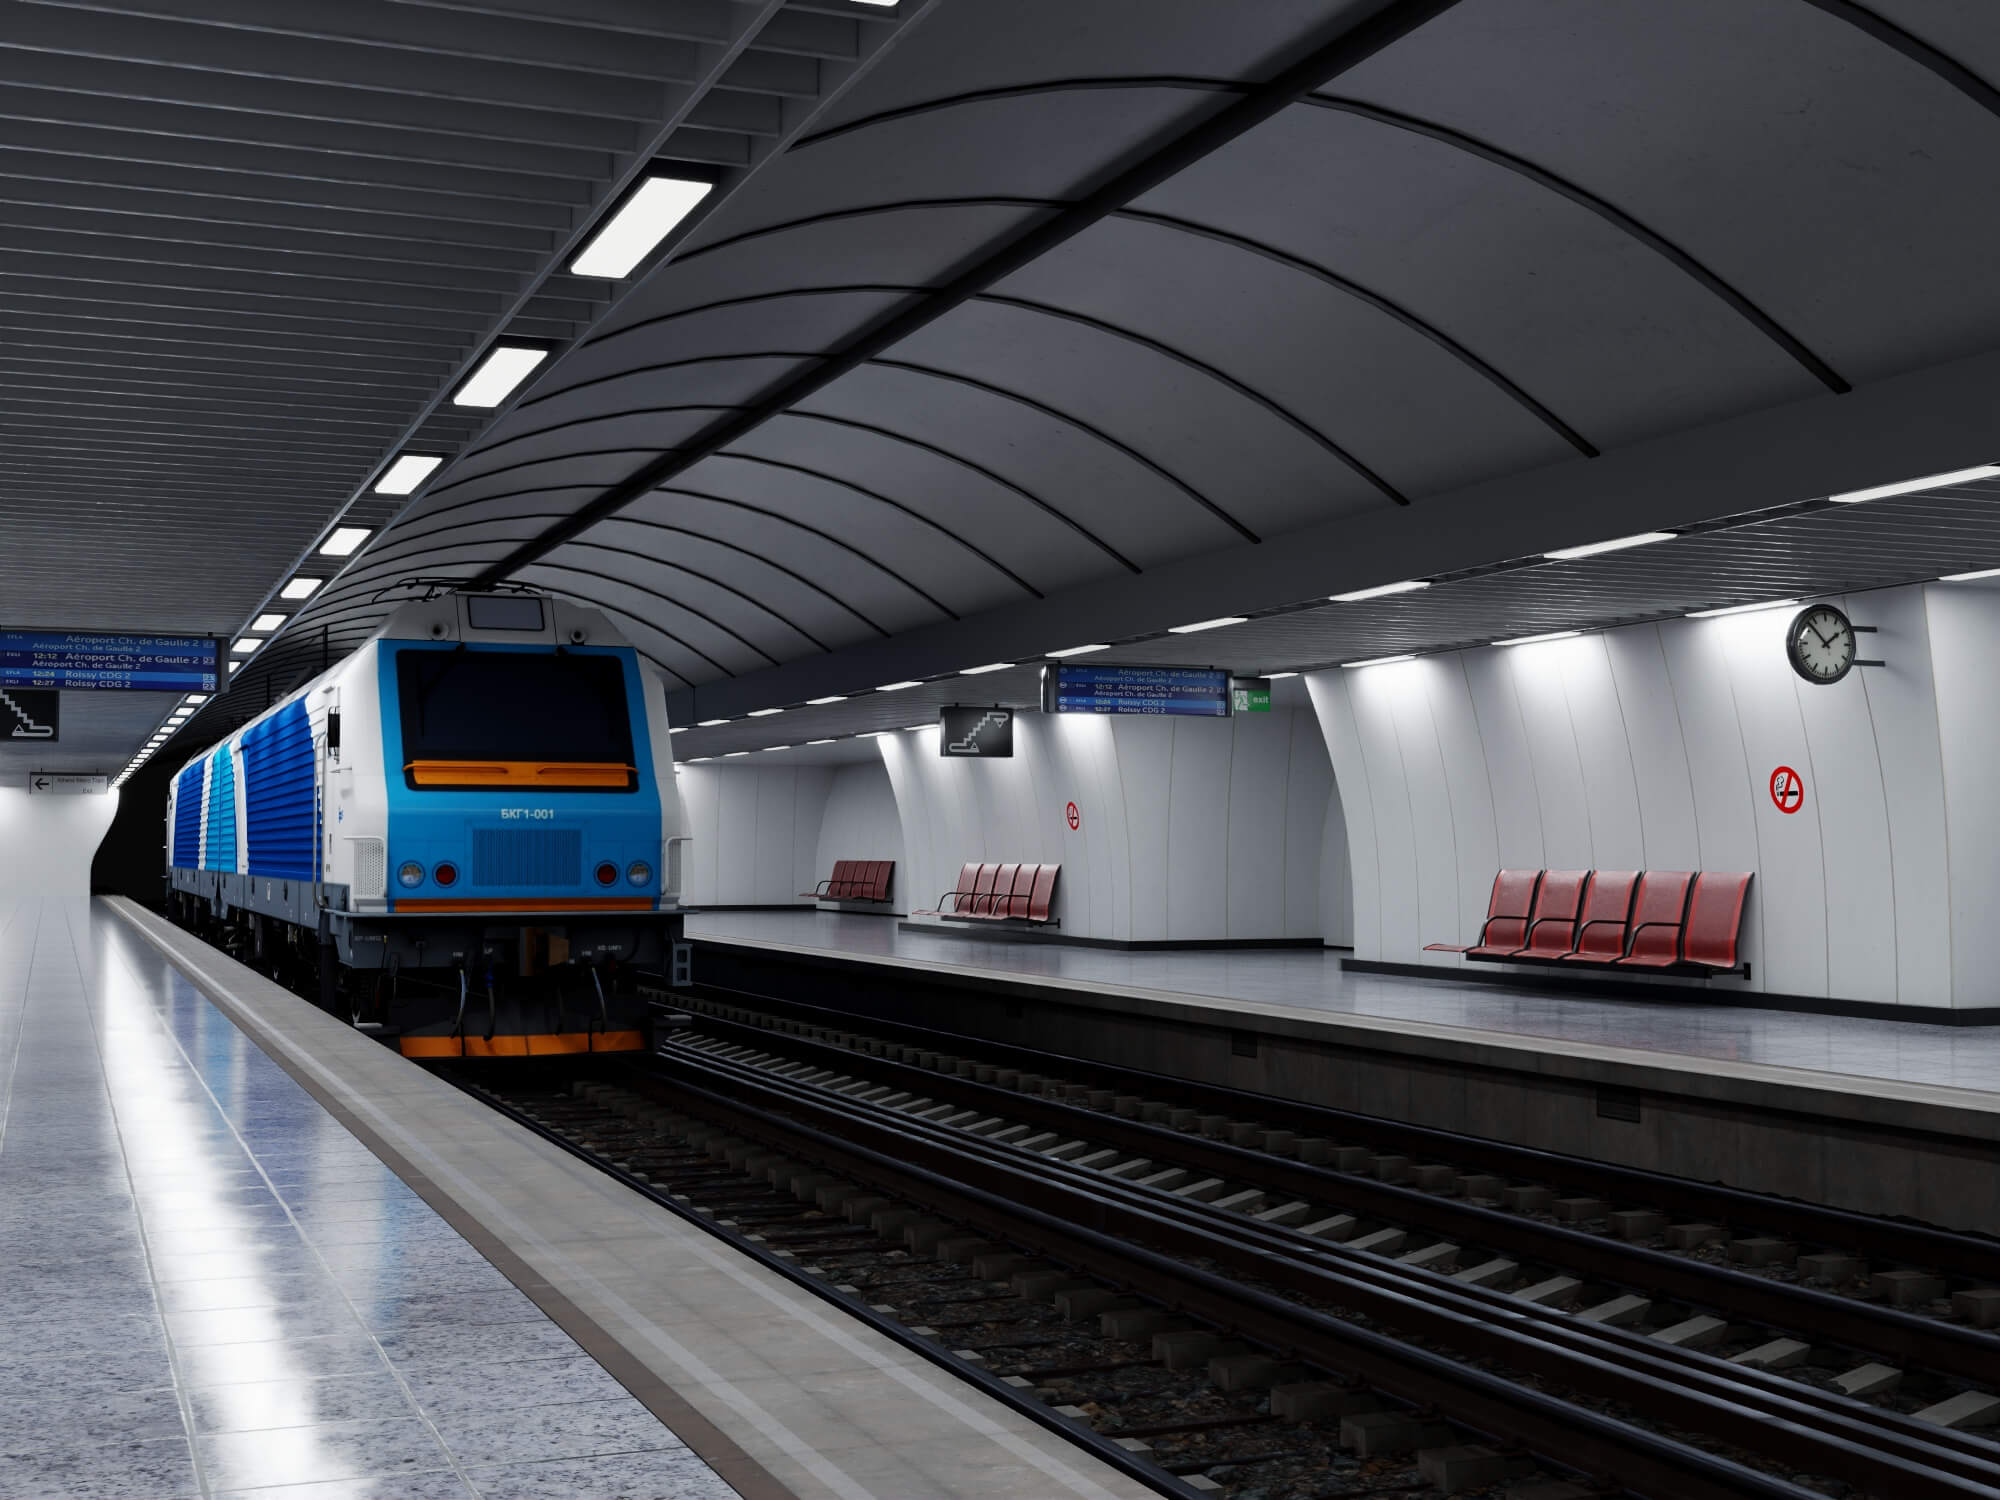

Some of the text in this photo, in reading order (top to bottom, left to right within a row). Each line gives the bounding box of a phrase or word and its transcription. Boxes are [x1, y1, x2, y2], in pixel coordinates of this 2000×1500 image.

[66, 635, 114, 645] Aéroport
[118, 636, 136, 645] Ch.
[155, 638, 190, 647] Gaulle
[191, 639, 200, 647] 2
[32, 642, 73, 651] Aéroport
[75, 643, 90, 651] Ch.
[105, 644, 134, 652] Gaulle
[33, 652, 57, 660] 12:12
[65, 652, 200, 664] Aéroport Ch. de Gaulle 2
[32, 660, 73, 669] Aéroport
[75, 661, 90, 669] Ch.
[92, 661, 103, 669] de
[105, 662, 134, 670] Gaulle
[65, 670, 97, 679] Roissy
[99, 670, 122, 679] CDG
[65, 679, 97, 688] Roissy
[99, 680, 122, 688] CDG
[1118, 683, 1153, 692] Aéroport
[1118, 698, 1140, 706] Roissy
[1253, 696, 1269, 704] exit
[1118, 706, 1140, 714] Roissy
[501, 808, 554, 819] БКГ1-001
